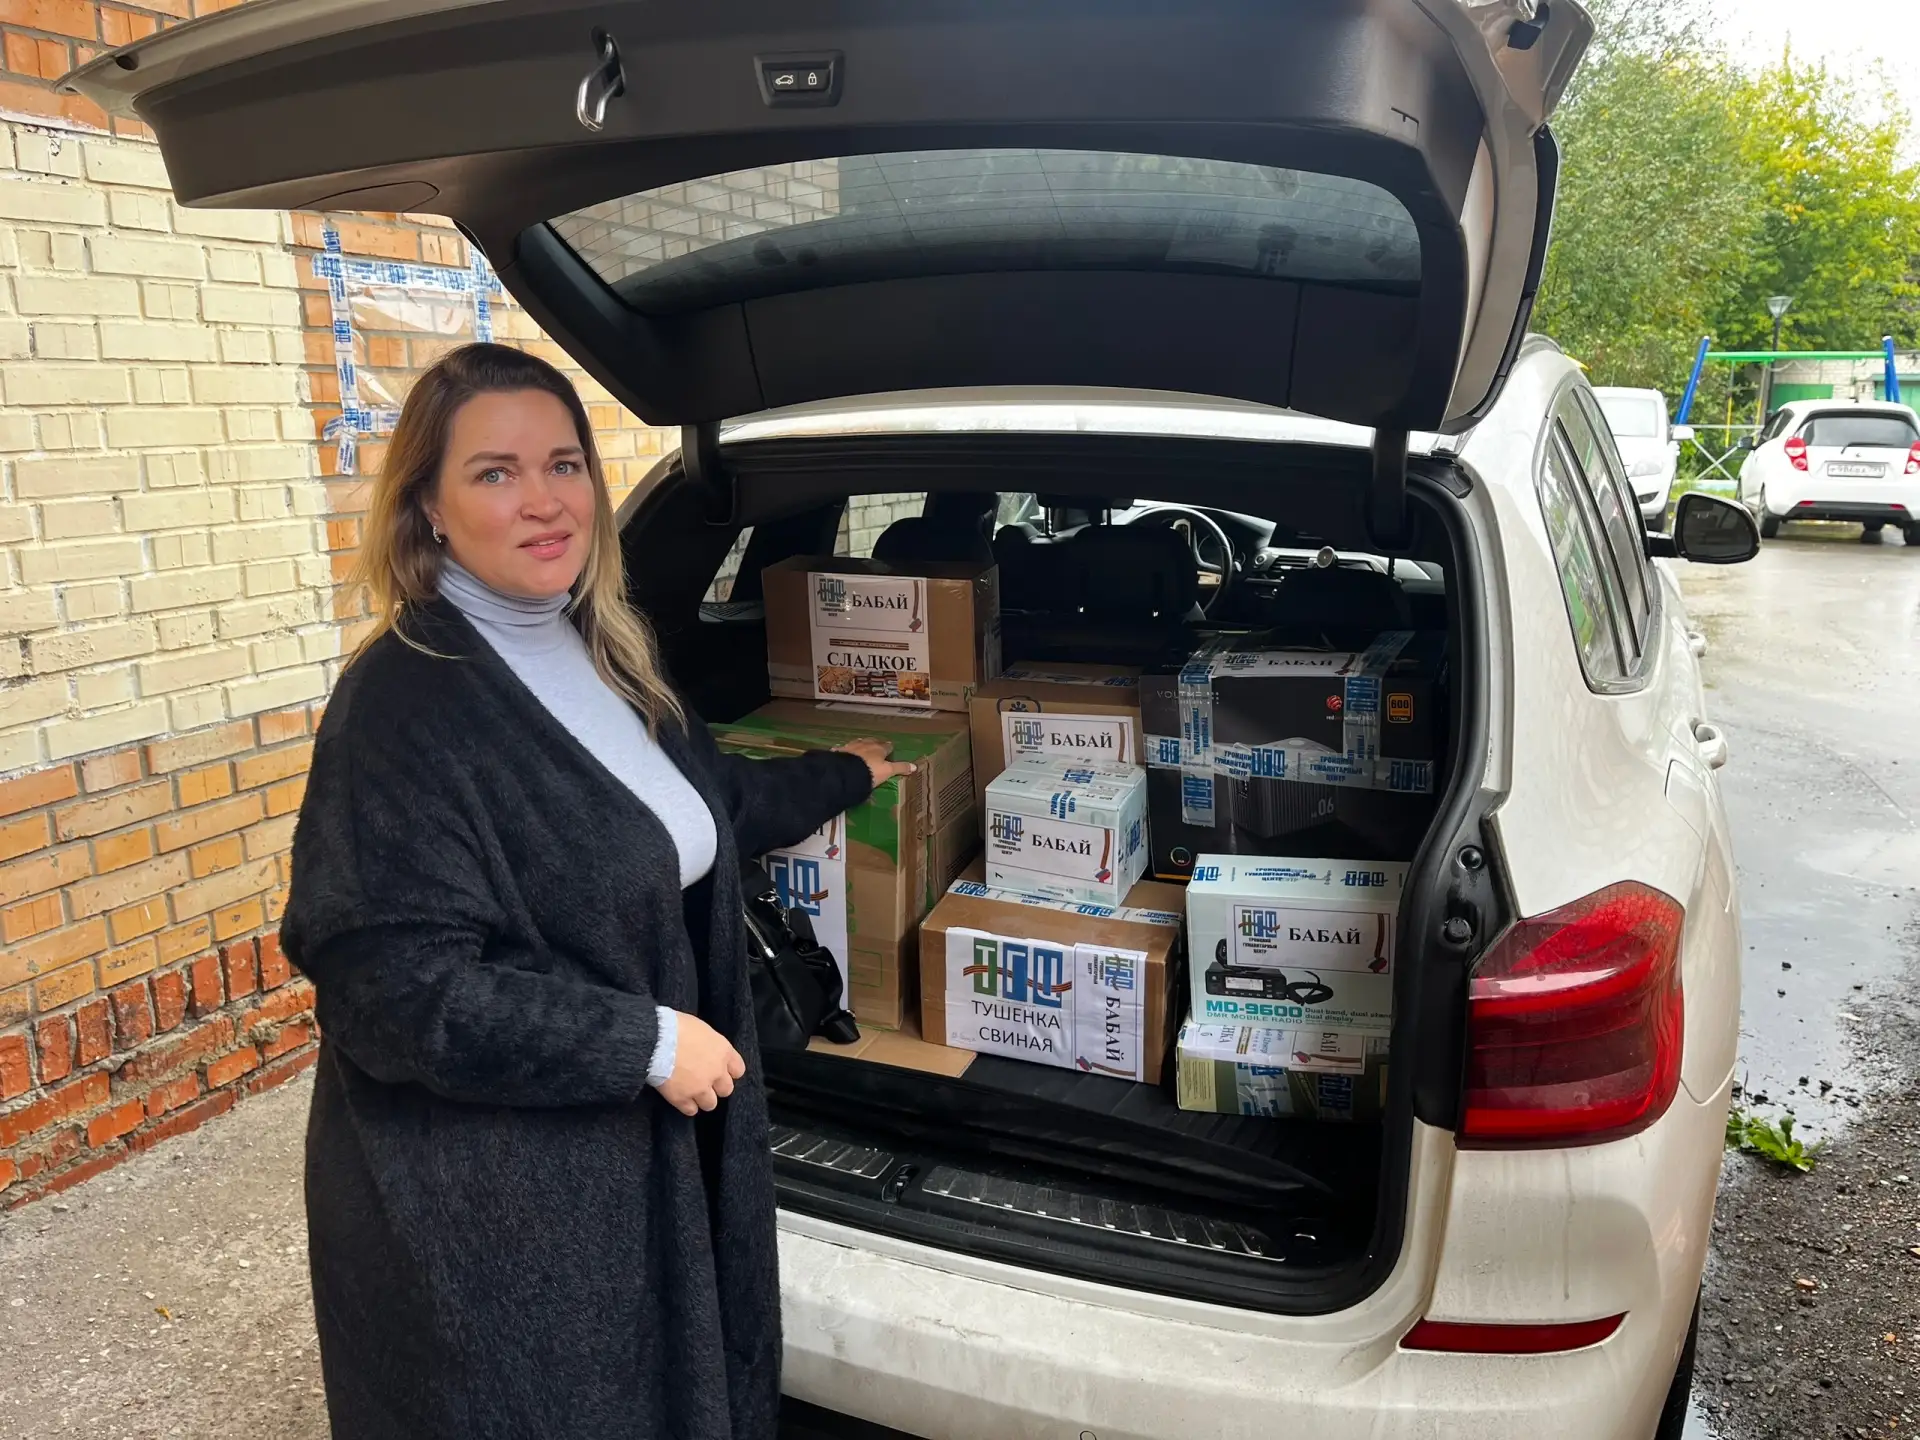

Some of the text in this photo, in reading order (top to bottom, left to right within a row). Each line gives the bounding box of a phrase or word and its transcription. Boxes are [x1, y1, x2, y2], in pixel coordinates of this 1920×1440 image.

[851, 593, 909, 610] БАБАЙ
[827, 651, 917, 671] СЛАДКОЕ
[1050, 731, 1113, 749] БАБАЙ
[1160, 738, 1180, 765] ТГ
[1032, 834, 1093, 857] БАБАЙ
[1288, 927, 1361, 945] БАБАЙ
[973, 937, 1064, 1009] ТГЦ
[971, 1000, 1061, 1029] ТУШЕНКА
[1206, 1000, 1303, 1018] MD-9600
[1206, 1011, 1229, 1019] DMR
[1230, 1013, 1268, 1022] MOBILE
[1271, 1016, 1303, 1024] RADIO
[979, 1026, 1053, 1053] СВИНАЯ
[1105, 995, 1124, 1063] БАБАЙ
[1218, 1025, 1236, 1044] НКА
[1320, 1032, 1341, 1054] БАЙ
